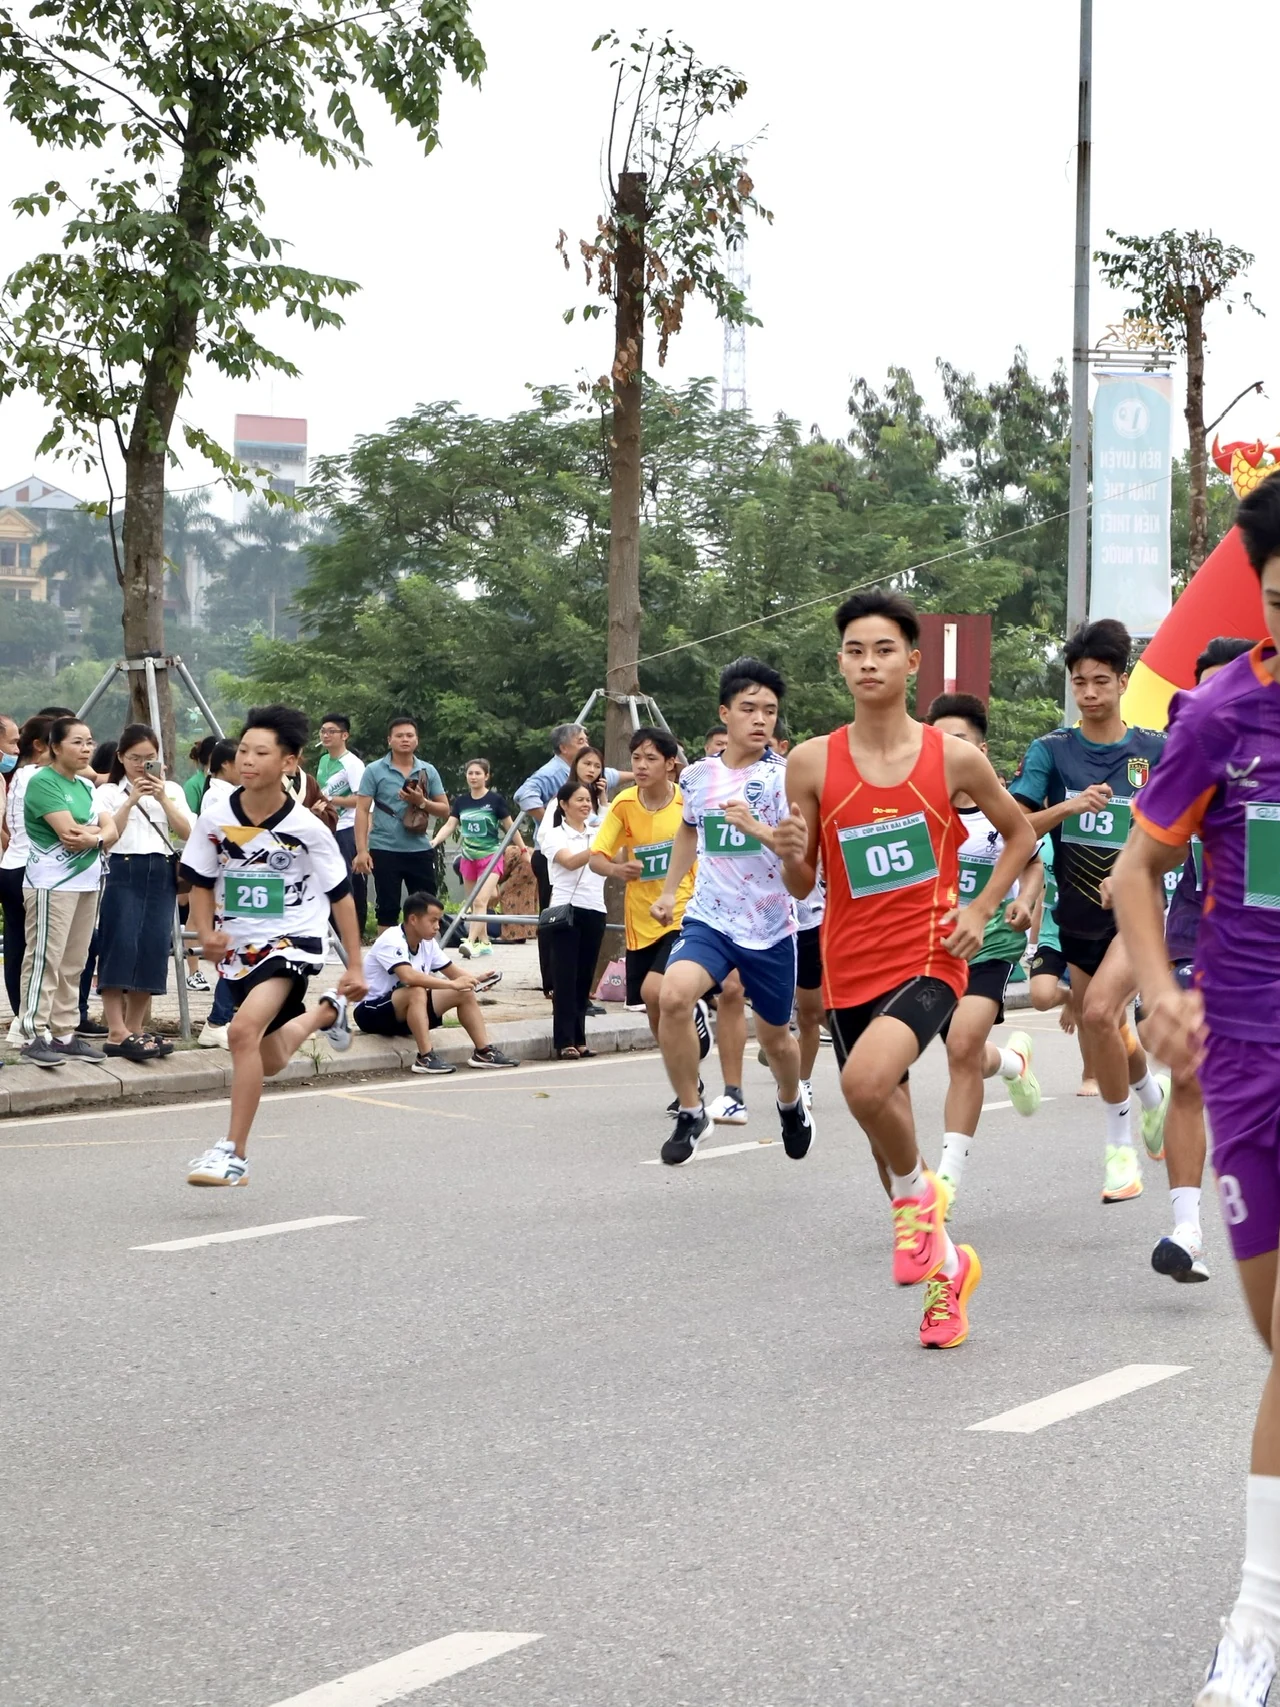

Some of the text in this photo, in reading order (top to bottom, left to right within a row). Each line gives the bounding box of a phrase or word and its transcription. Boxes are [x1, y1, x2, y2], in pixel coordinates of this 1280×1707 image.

[468, 823, 480, 832] 43
[1079, 811, 1114, 835] 03
[717, 824, 746, 846] 78
[645, 853, 668, 872] 77
[866, 840, 914, 877] 05
[237, 886, 268, 908] 26
